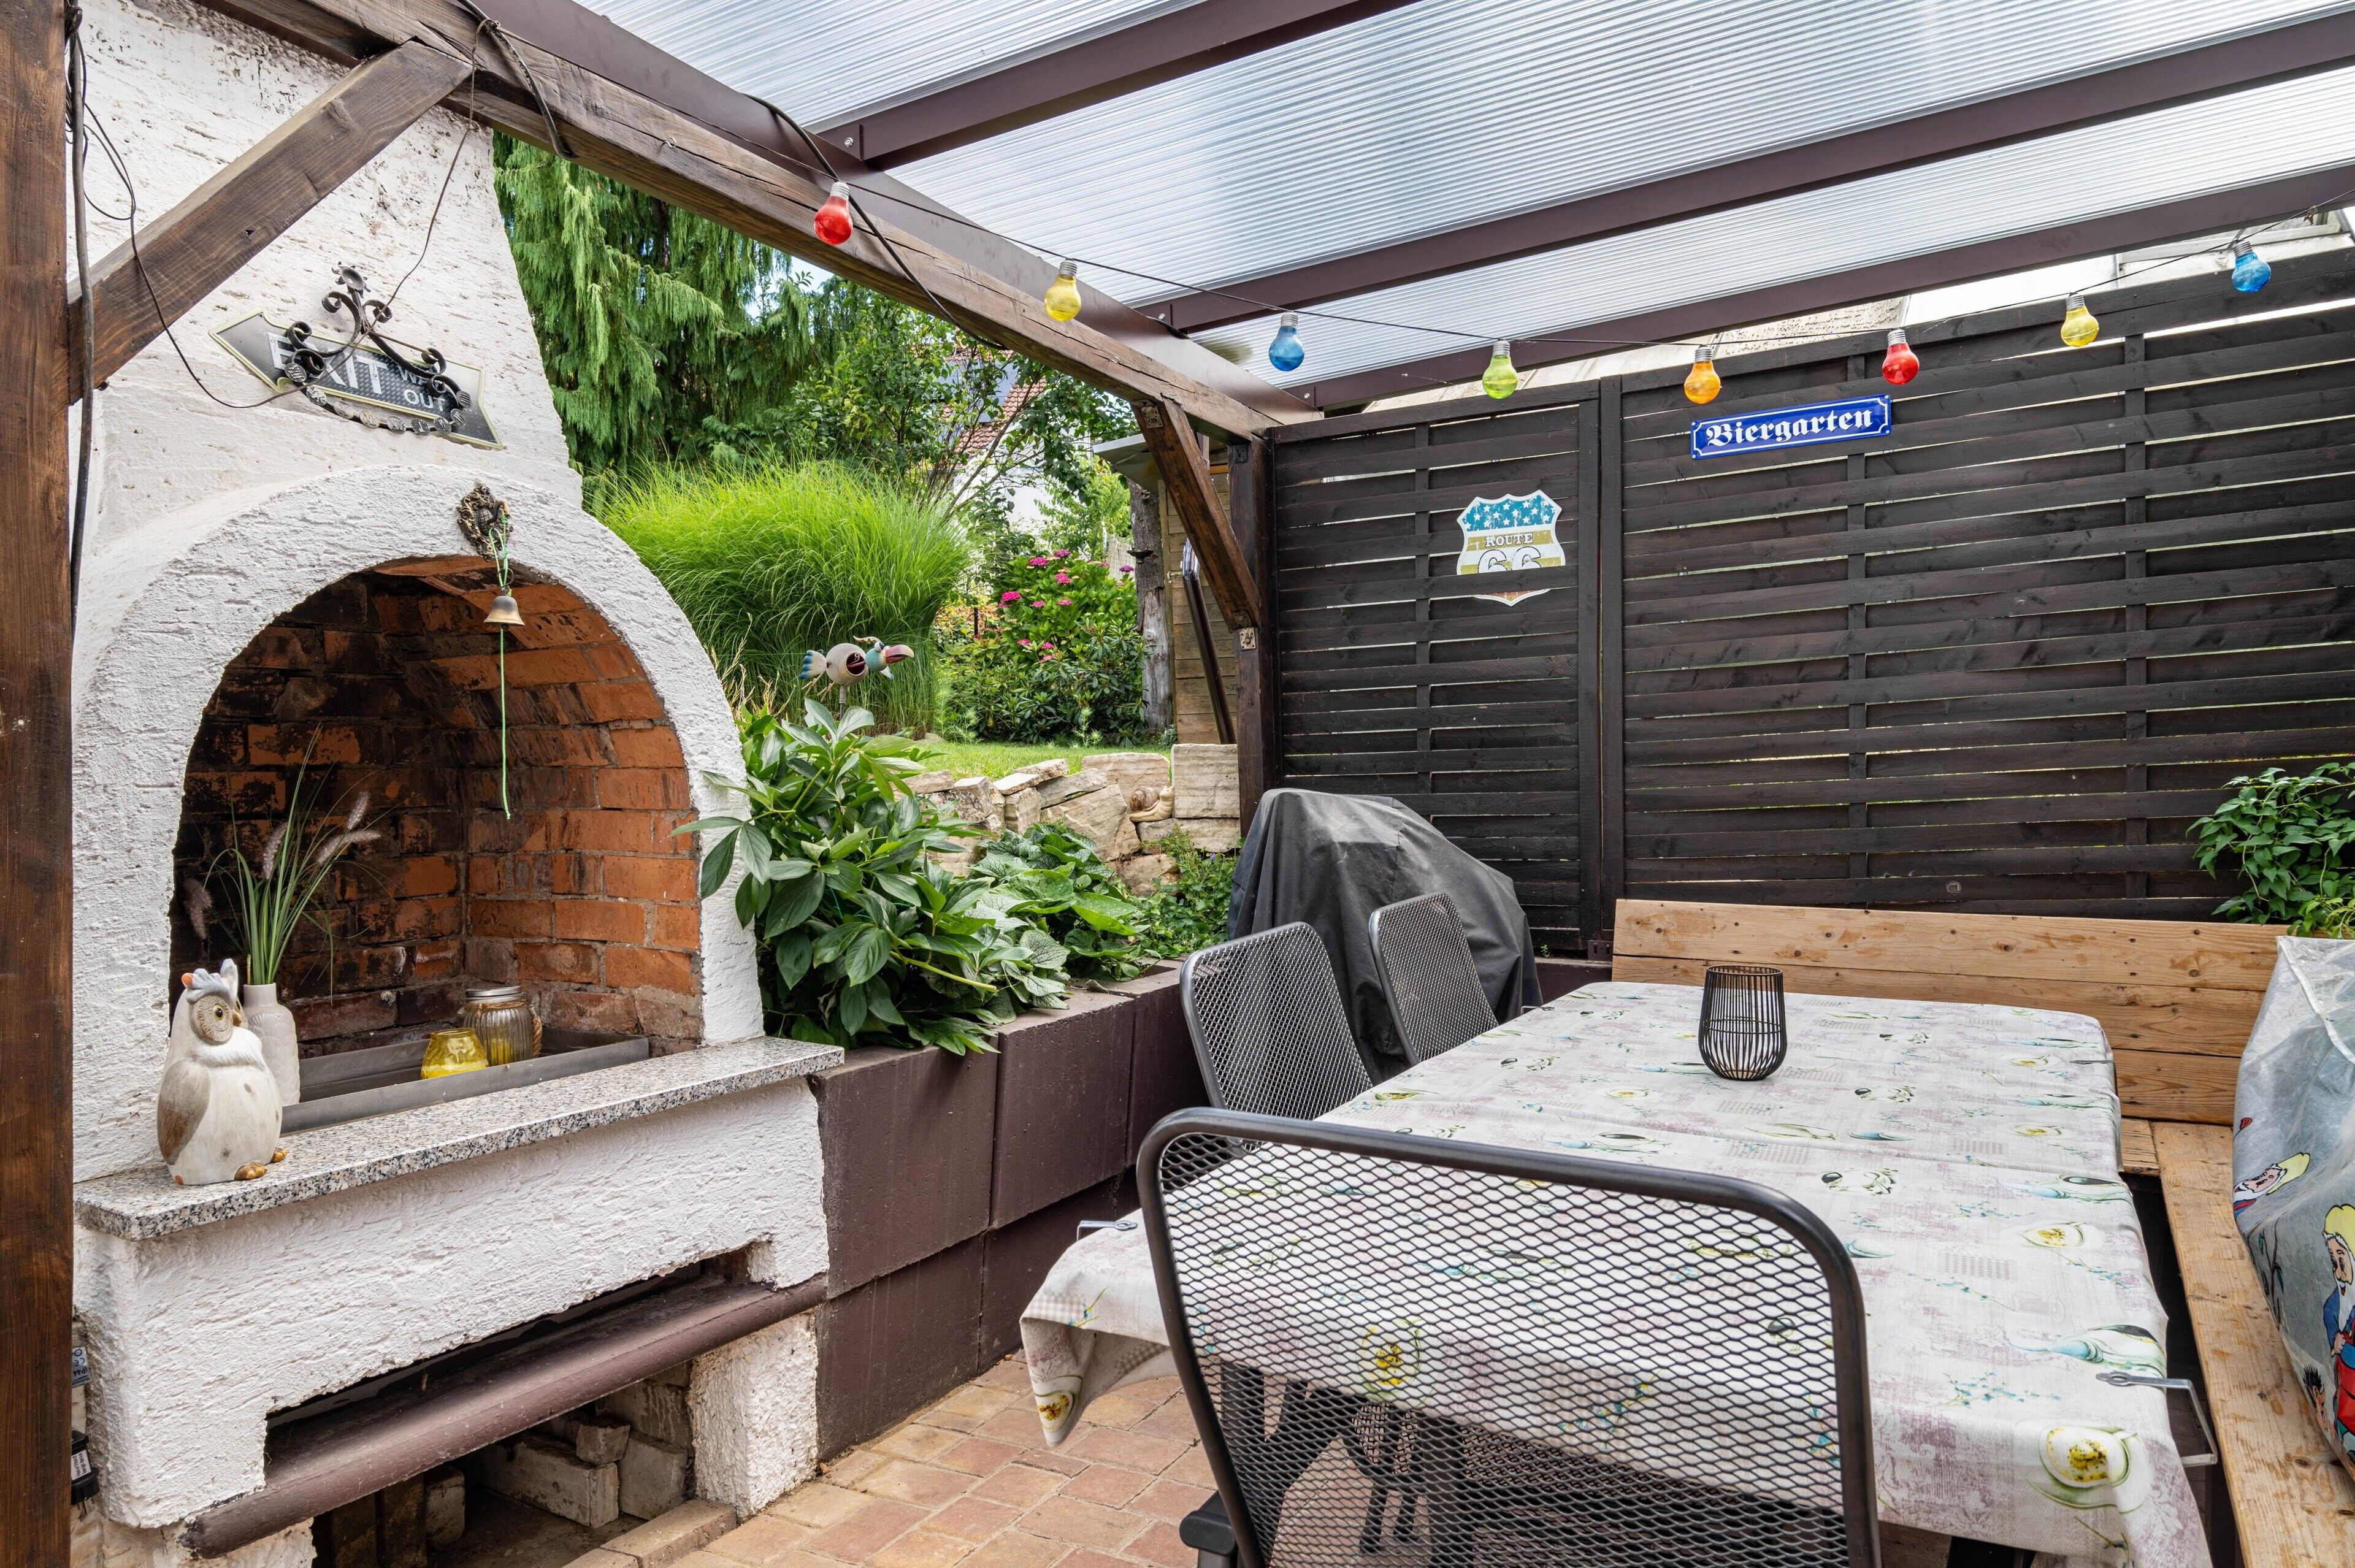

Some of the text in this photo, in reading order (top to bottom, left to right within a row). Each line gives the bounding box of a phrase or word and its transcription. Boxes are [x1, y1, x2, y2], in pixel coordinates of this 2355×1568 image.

[404, 389, 445, 412] OUT
[1706, 409, 1873, 447] Biergarten
[1485, 532, 1533, 548] ROUTE
[73, 1366, 88, 1377] IP44
